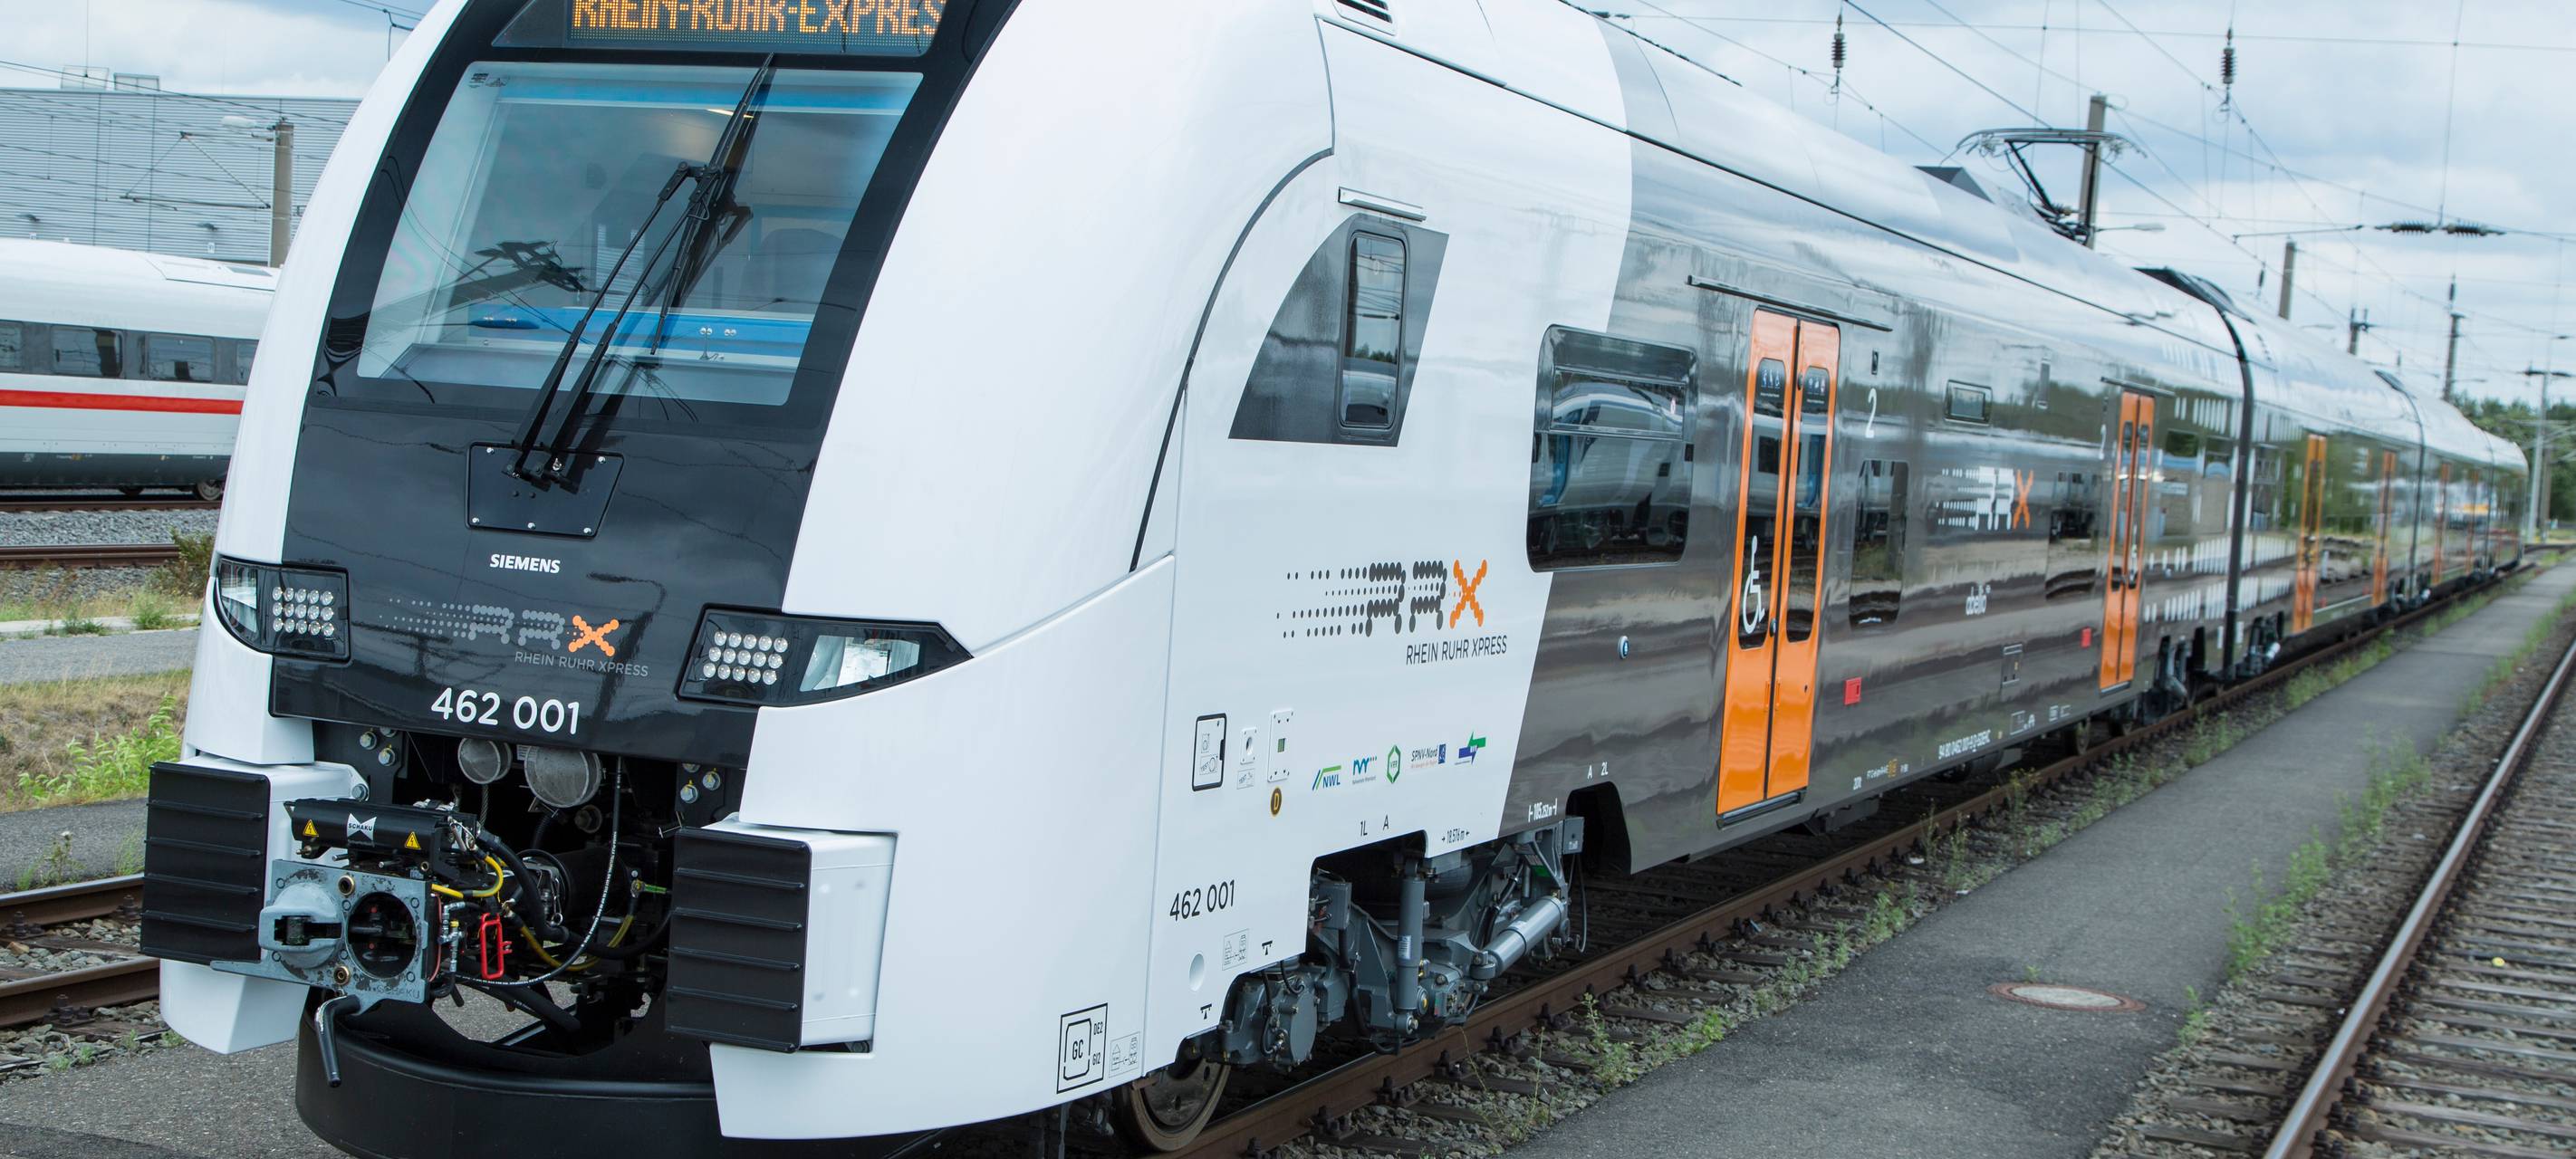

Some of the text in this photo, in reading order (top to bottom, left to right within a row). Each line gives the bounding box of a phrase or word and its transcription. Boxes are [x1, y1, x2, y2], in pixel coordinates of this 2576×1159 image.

[1865, 388, 1877, 438] 2
[489, 553, 561, 574] SIEMENS
[1365, 560, 1487, 637] RRX
[1406, 635, 1507, 666] RHEIN RUHR XPRESS
[514, 651, 649, 677] RHEIN RUHR XPRESS
[430, 687, 580, 734] 462 001
[1322, 773, 1341, 789] NWL
[1587, 764, 1592, 779] A
[348, 822, 373, 831] SCHAKU
[1360, 814, 1389, 837] 1L A
[1169, 879, 1235, 922] 462 001
[1072, 1039, 1084, 1060] GC
